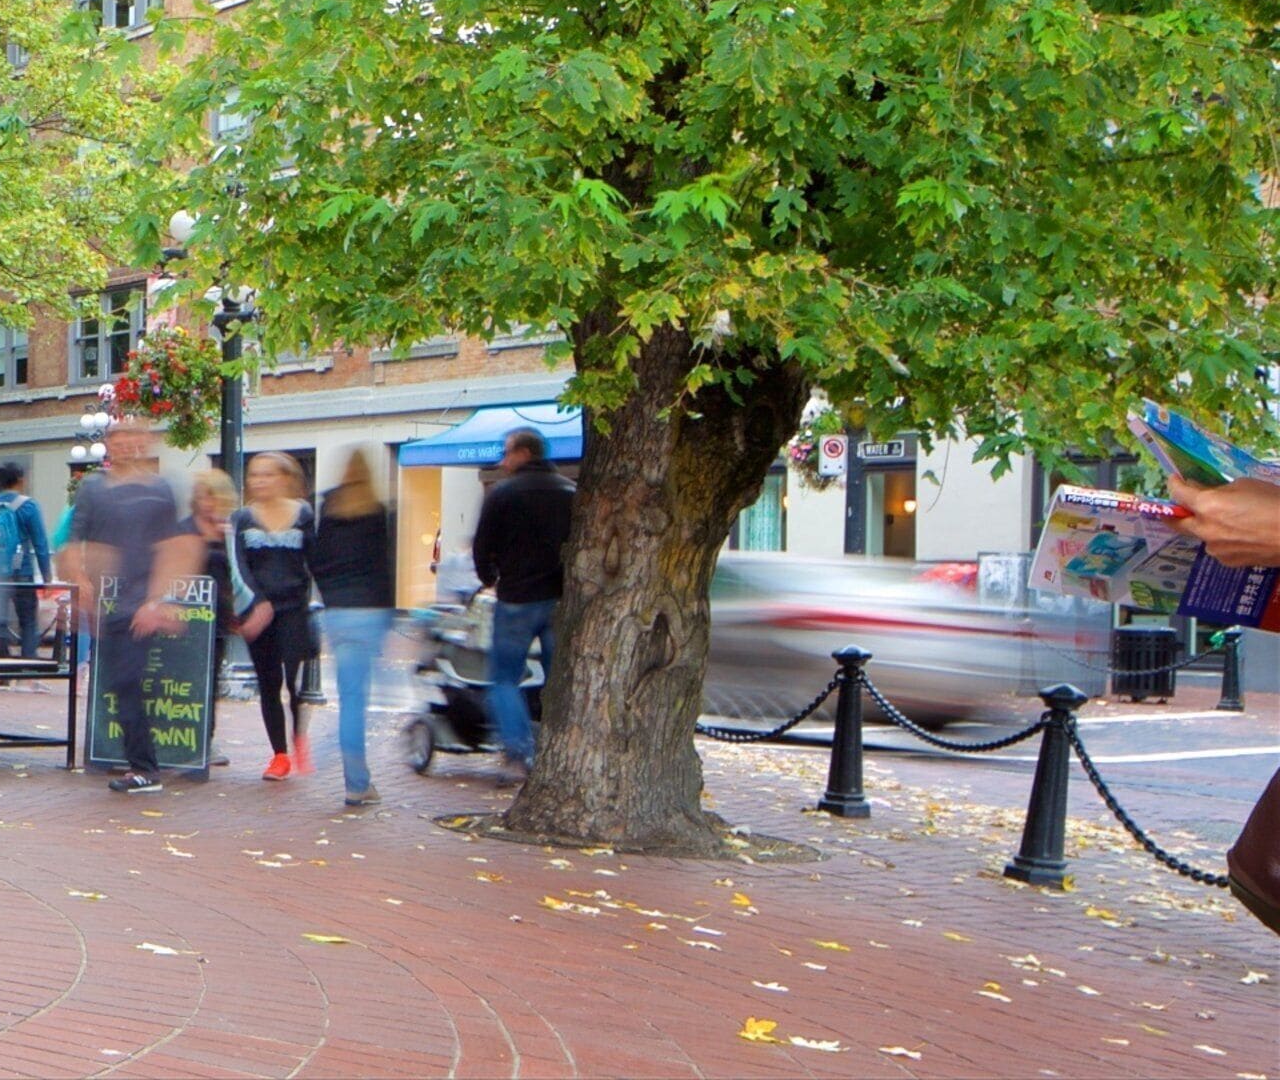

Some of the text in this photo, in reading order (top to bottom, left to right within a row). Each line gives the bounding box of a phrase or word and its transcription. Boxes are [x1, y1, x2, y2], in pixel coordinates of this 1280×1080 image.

[458, 445, 506, 460] one wate
[160, 678, 192, 697] THE
[154, 697, 204, 722] MEAT
